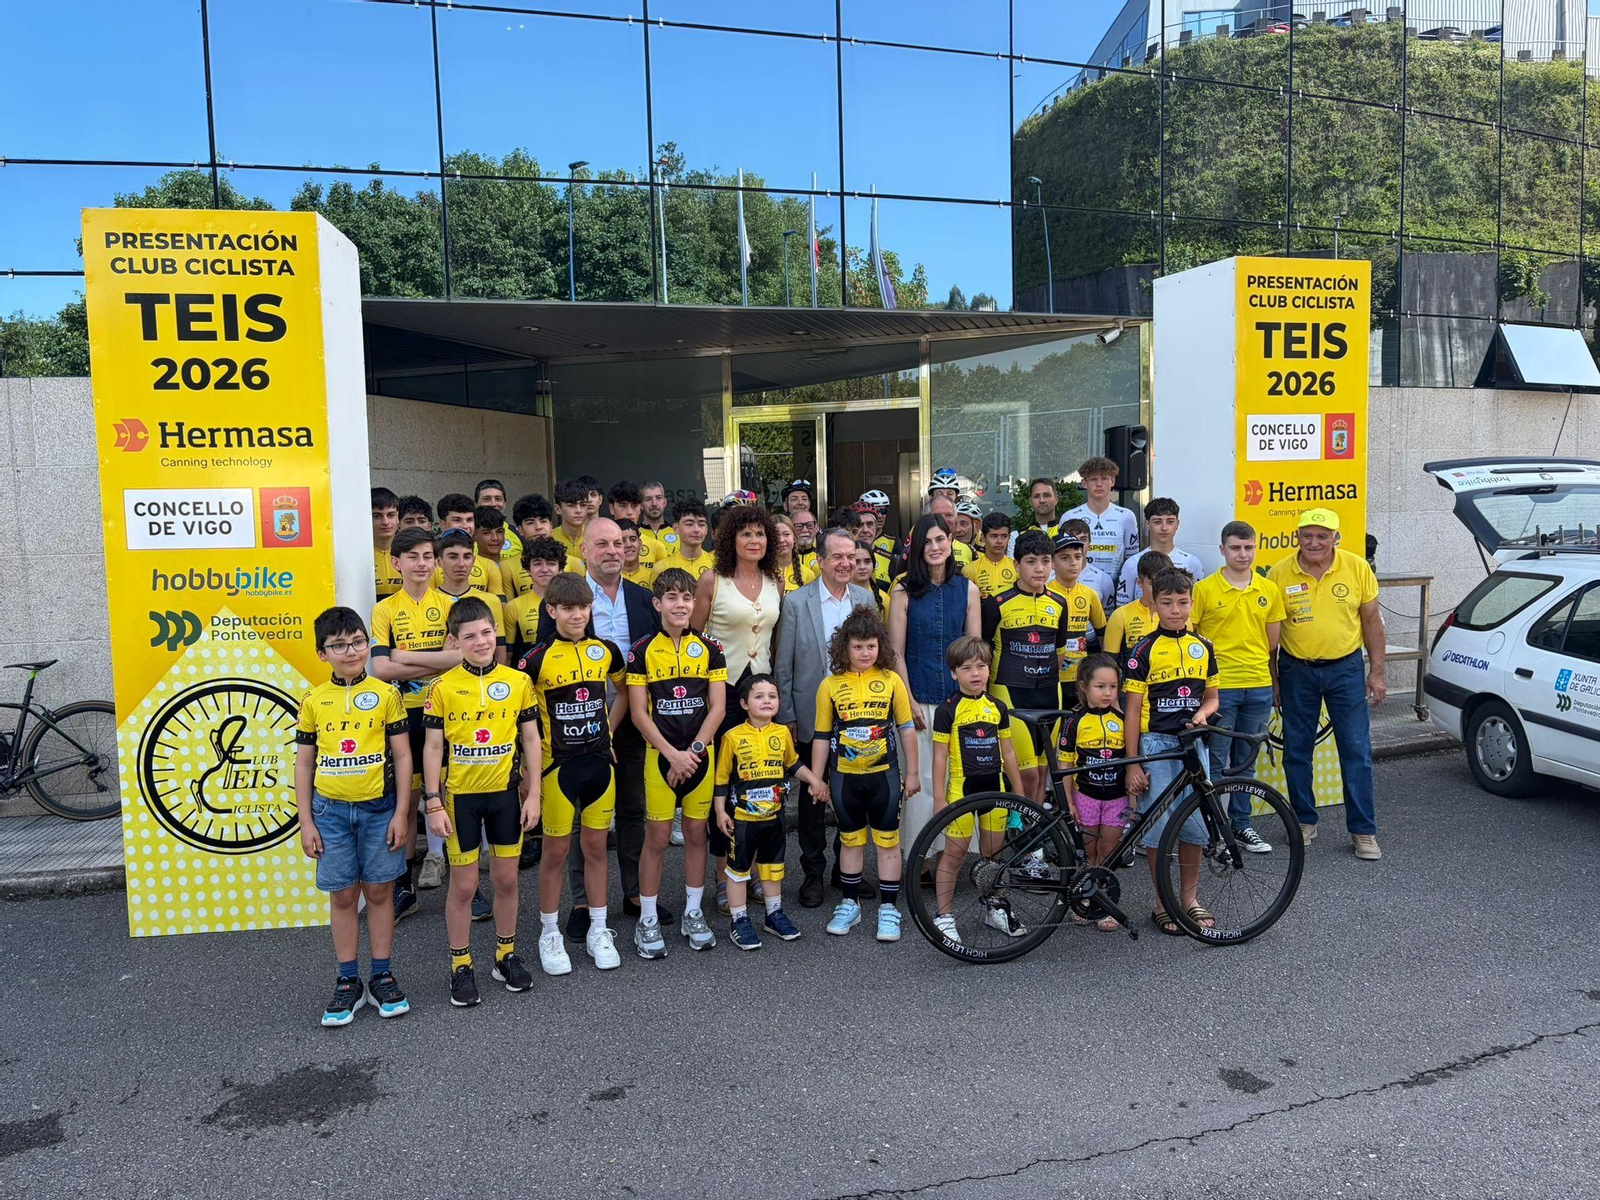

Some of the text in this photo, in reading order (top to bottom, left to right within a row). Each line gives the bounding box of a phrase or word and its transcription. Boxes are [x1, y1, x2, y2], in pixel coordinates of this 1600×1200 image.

[105, 229, 298, 252] PRESENTACIÓN
[110, 257, 295, 277] CLUB CICLISTA
[1247, 274, 1359, 291] PRESENTACIÓN
[1248, 294, 1356, 310] CLUB CICLISTA
[125, 292, 287, 343] TEIS
[1255, 321, 1349, 360] TEIS
[150, 357, 271, 391] 2026
[1266, 370, 1336, 396] 2026
[158, 421, 314, 449] Hermasa
[1251, 423, 1316, 436] CONCELLO
[1258, 438, 1308, 450] DE VIGO
[160, 456, 273, 469] Canning technology
[1268, 481, 1358, 503] Hermasa
[133, 500, 244, 517] CONCELLO
[1268, 508, 1296, 518] Canning
[149, 520, 233, 536] DE VIGO
[152, 566, 294, 597] hobbybike
[245, 589, 293, 598] hobbybike.es
[210, 612, 302, 629] Deputación
[211, 628, 303, 642] Pontevedra
[420, 629, 445, 638] TEIS
[408, 640, 442, 649] Hermasa
[1450, 652, 1490, 671] DECATHLON
[1569, 682, 1580, 691] DE
[1572, 673, 1598, 685] XUNTA
[863, 700, 889, 709] TEIS
[850, 710, 882, 718] Hermasa
[453, 743, 513, 757] Hermasa
[319, 753, 383, 768] Hermasa
[1224, 784, 1267, 799] HIGH LEVEL
[995, 800, 1043, 823] HIGH LEVEL
[1200, 928, 1242, 939] HIGH LEVEL
[941, 936, 988, 958] HIGH LEVEL
